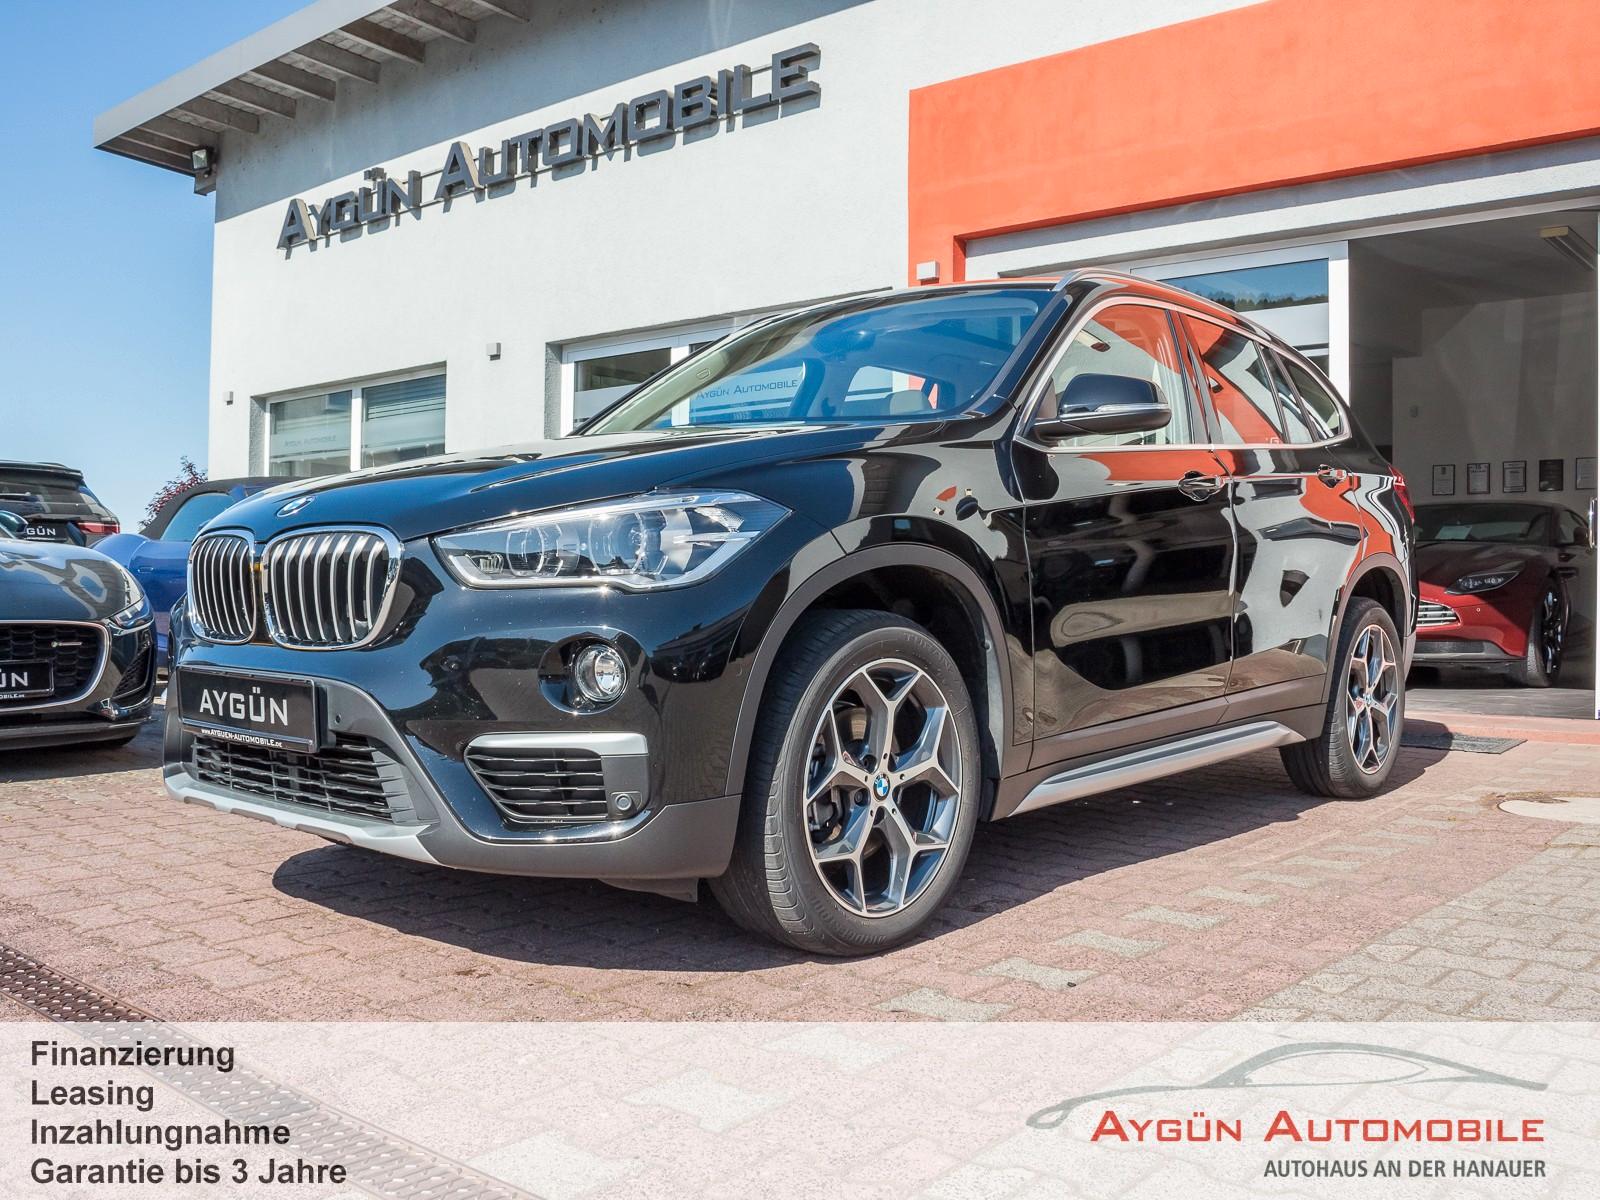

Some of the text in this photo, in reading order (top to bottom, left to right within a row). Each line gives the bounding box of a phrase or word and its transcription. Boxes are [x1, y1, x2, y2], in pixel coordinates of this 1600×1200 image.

[277, 42, 821, 251] AYGÜN AUTOMOBILE
[734, 379, 798, 394] AUTOMOBILE
[199, 686, 289, 727] AYGÜN
